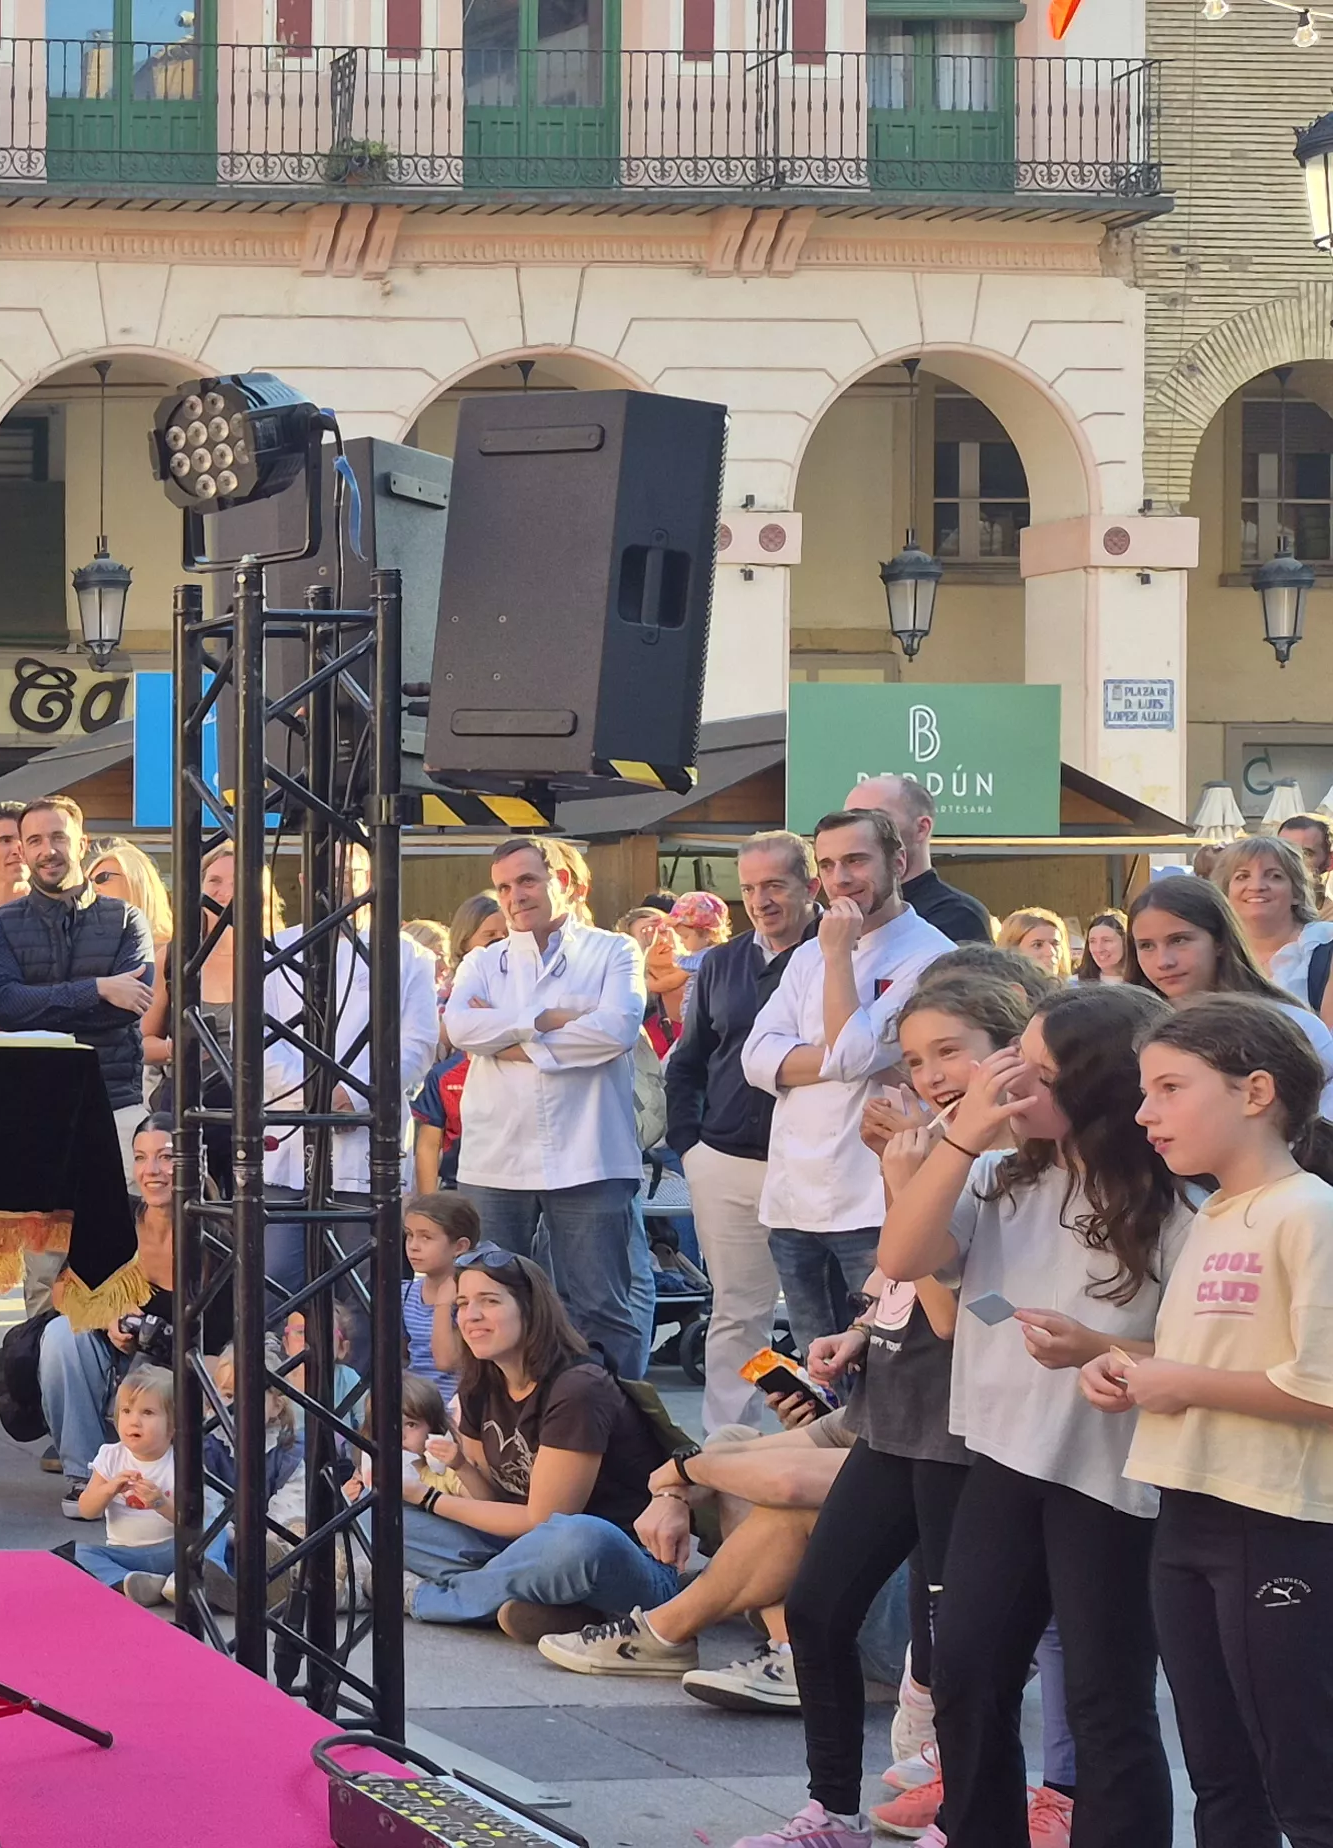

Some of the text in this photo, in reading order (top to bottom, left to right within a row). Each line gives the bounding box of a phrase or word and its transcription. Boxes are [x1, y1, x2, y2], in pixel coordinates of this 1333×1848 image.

[1124, 686, 1155, 697] PLAZA
[1138, 698, 1164, 710] LUIS
[856, 764, 994, 797] DÚN
[1202, 1252, 1263, 1274] COOL
[1196, 1281, 1260, 1303] CLUB
